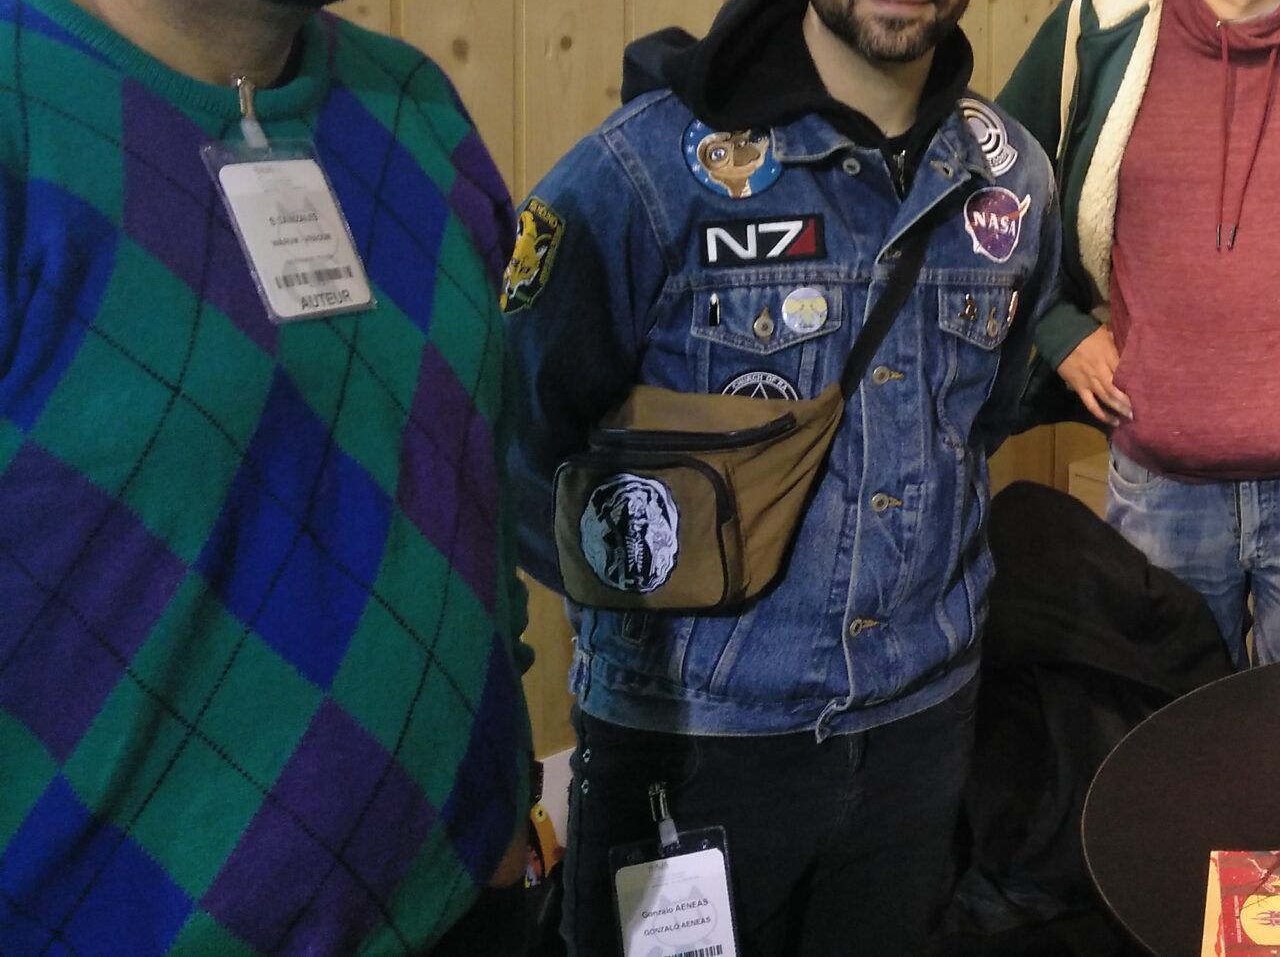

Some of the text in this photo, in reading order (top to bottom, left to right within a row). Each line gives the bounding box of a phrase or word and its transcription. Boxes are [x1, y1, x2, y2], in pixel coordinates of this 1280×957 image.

[973, 210, 1016, 236] NASA
[706, 220, 803, 263] N7
[301, 289, 353, 311] AUTEUR
[731, 373, 763, 389] CHURCH
[765, 374, 777, 383] OF
[641, 898, 709, 919] Gonzalo AENEAS
[643, 916, 712, 936] GONZALO AENEAS
